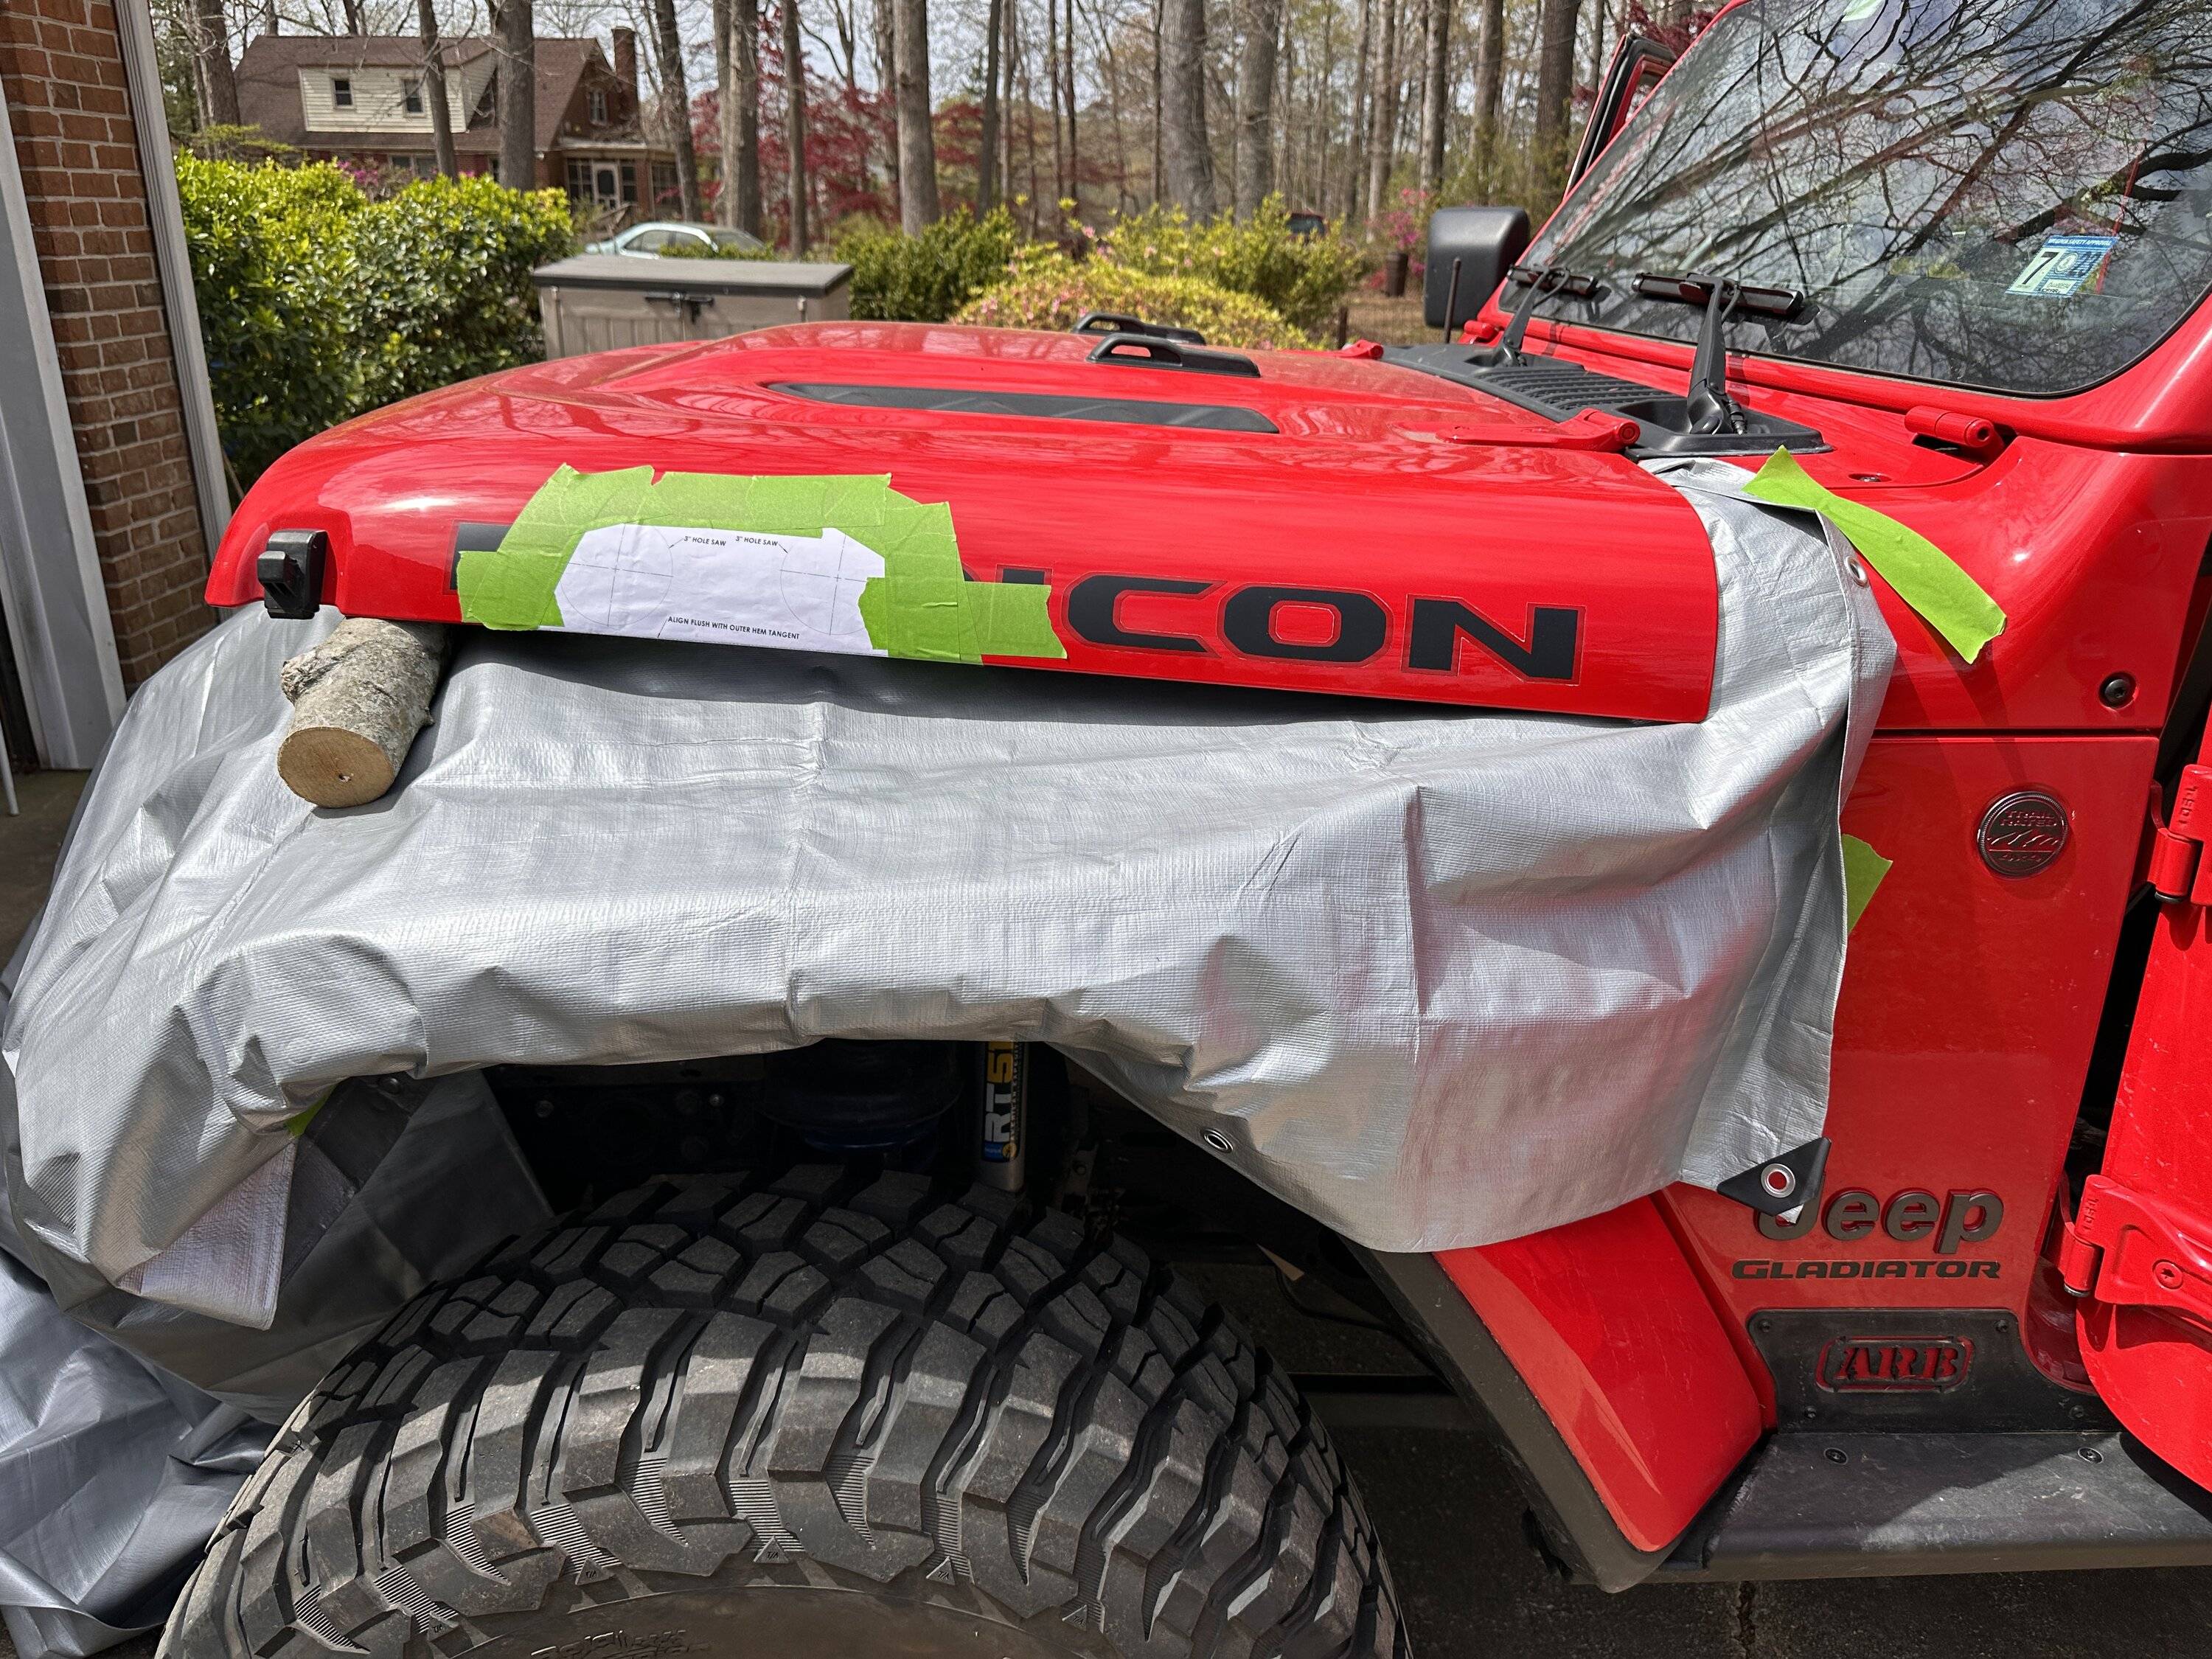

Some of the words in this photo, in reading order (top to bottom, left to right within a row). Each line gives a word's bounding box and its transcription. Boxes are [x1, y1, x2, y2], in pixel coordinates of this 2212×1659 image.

[2022, 251, 2059, 285] 7
[744, 537, 761, 545] HOLE
[667, 616, 689, 625] ALIGN
[690, 619, 710, 627] FLUSH
[712, 622, 728, 630] WITH
[729, 625, 751, 633] OUTER
[752, 627, 767, 636] HEM
[768, 629, 800, 640] TANGENT
[1753, 1183, 2004, 1253] Jeep
[1732, 1259, 2001, 1280] GLADIATOR
[1833, 1346, 1959, 1380] ARB
